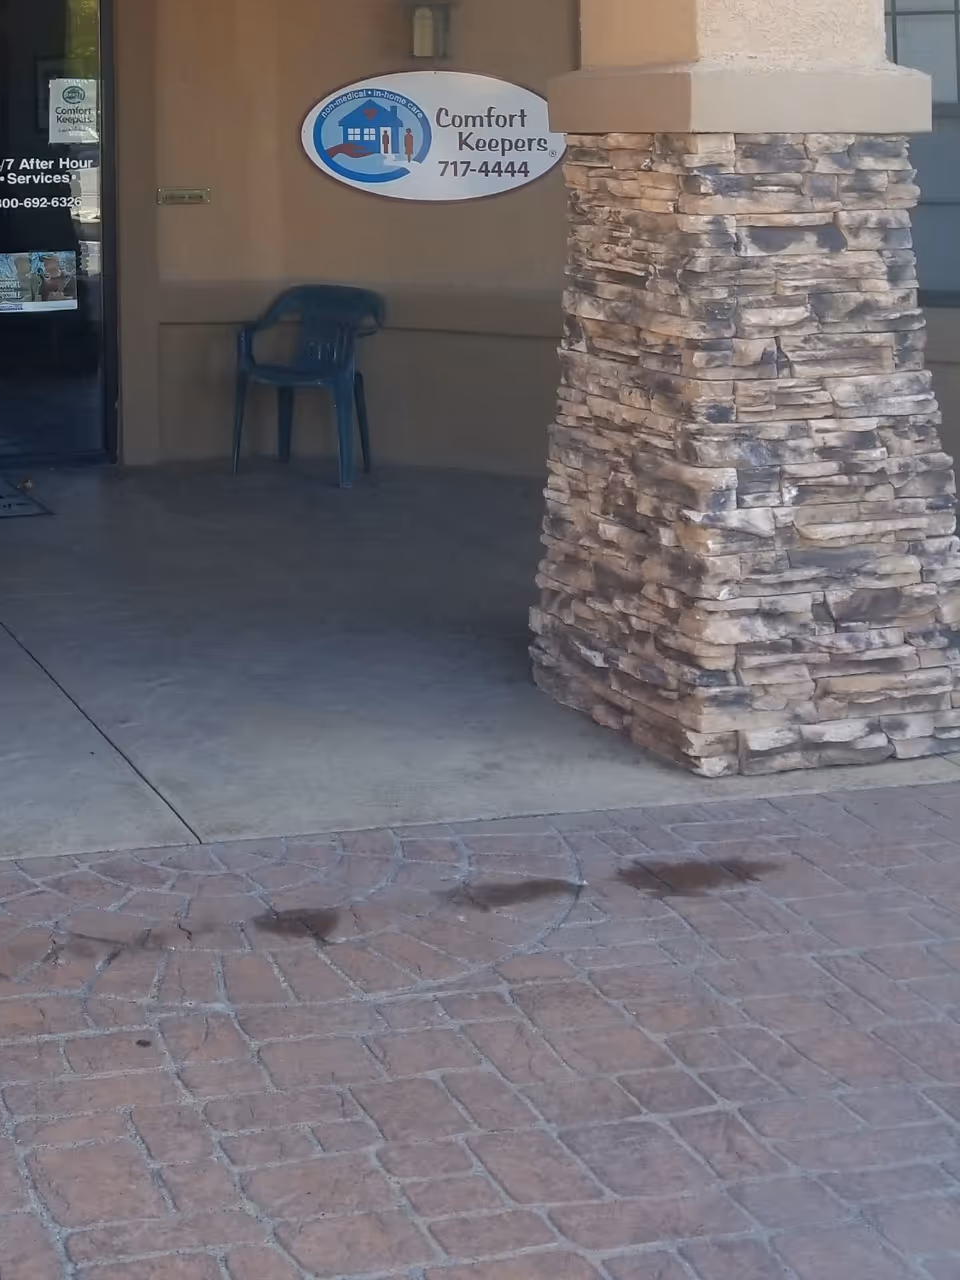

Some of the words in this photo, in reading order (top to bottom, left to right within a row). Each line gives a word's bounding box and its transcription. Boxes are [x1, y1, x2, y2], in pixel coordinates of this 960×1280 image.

[55, 106, 92, 115] Comfort
[321, 90, 367, 118] non-medical
[373, 89, 407, 105] in-home
[408, 103, 423, 119] care
[436, 106, 527, 128] Comfort
[458, 131, 548, 157] Keepers
[19, 158, 54, 170] After
[59, 157, 94, 169] Hour
[438, 160, 530, 177] 717-4444
[7, 172, 71, 185] Services
